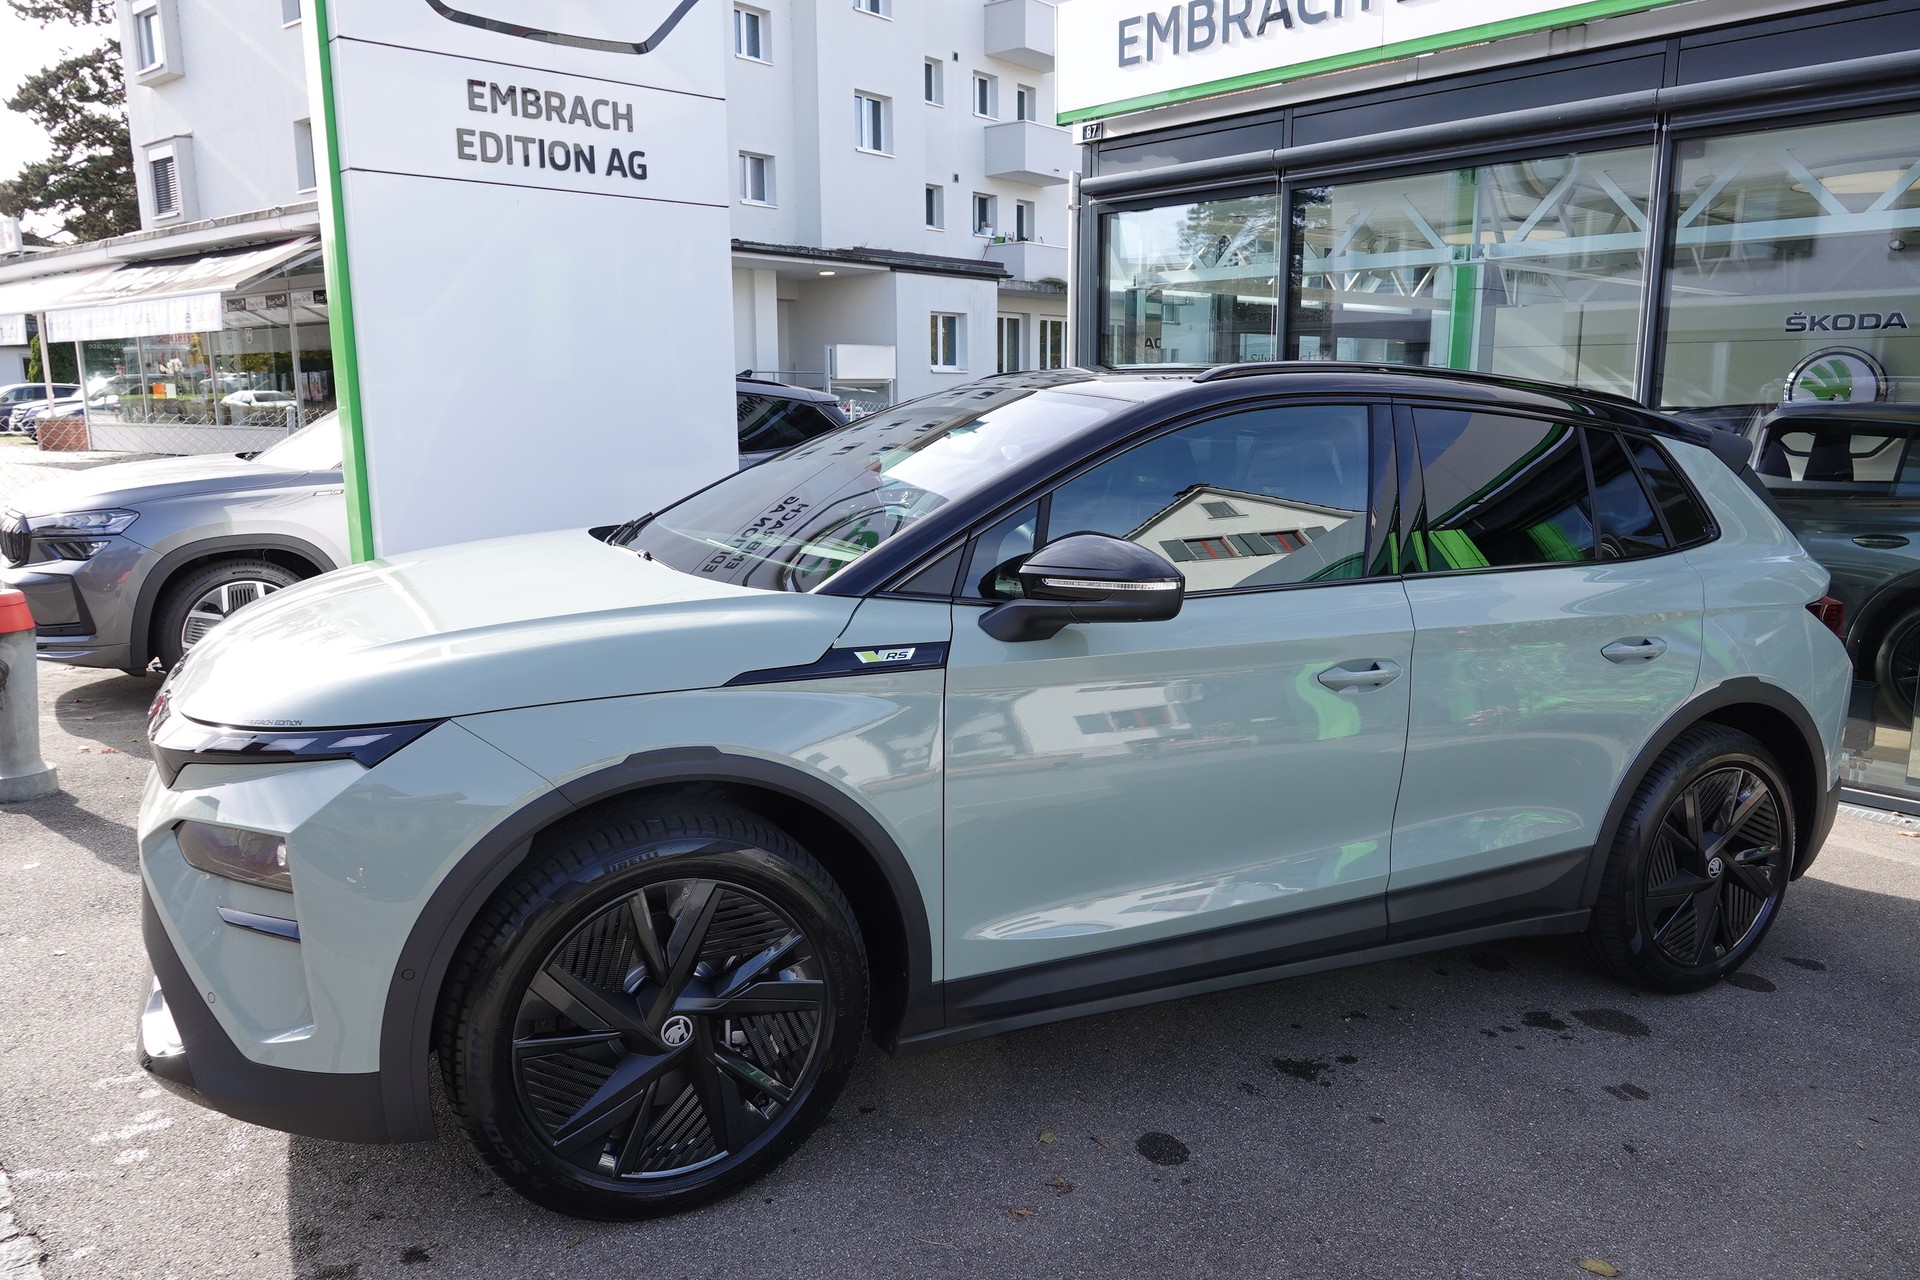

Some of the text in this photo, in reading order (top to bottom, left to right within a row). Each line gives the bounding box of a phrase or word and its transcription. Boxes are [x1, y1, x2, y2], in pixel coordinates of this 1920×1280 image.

[1118, 0, 1372, 68] EMBRAC
[467, 79, 633, 133] EMBRACH
[1086, 125, 1097, 139] 87
[456, 128, 648, 181] EDITION AG
[1785, 310, 1908, 333] ŠKODA
